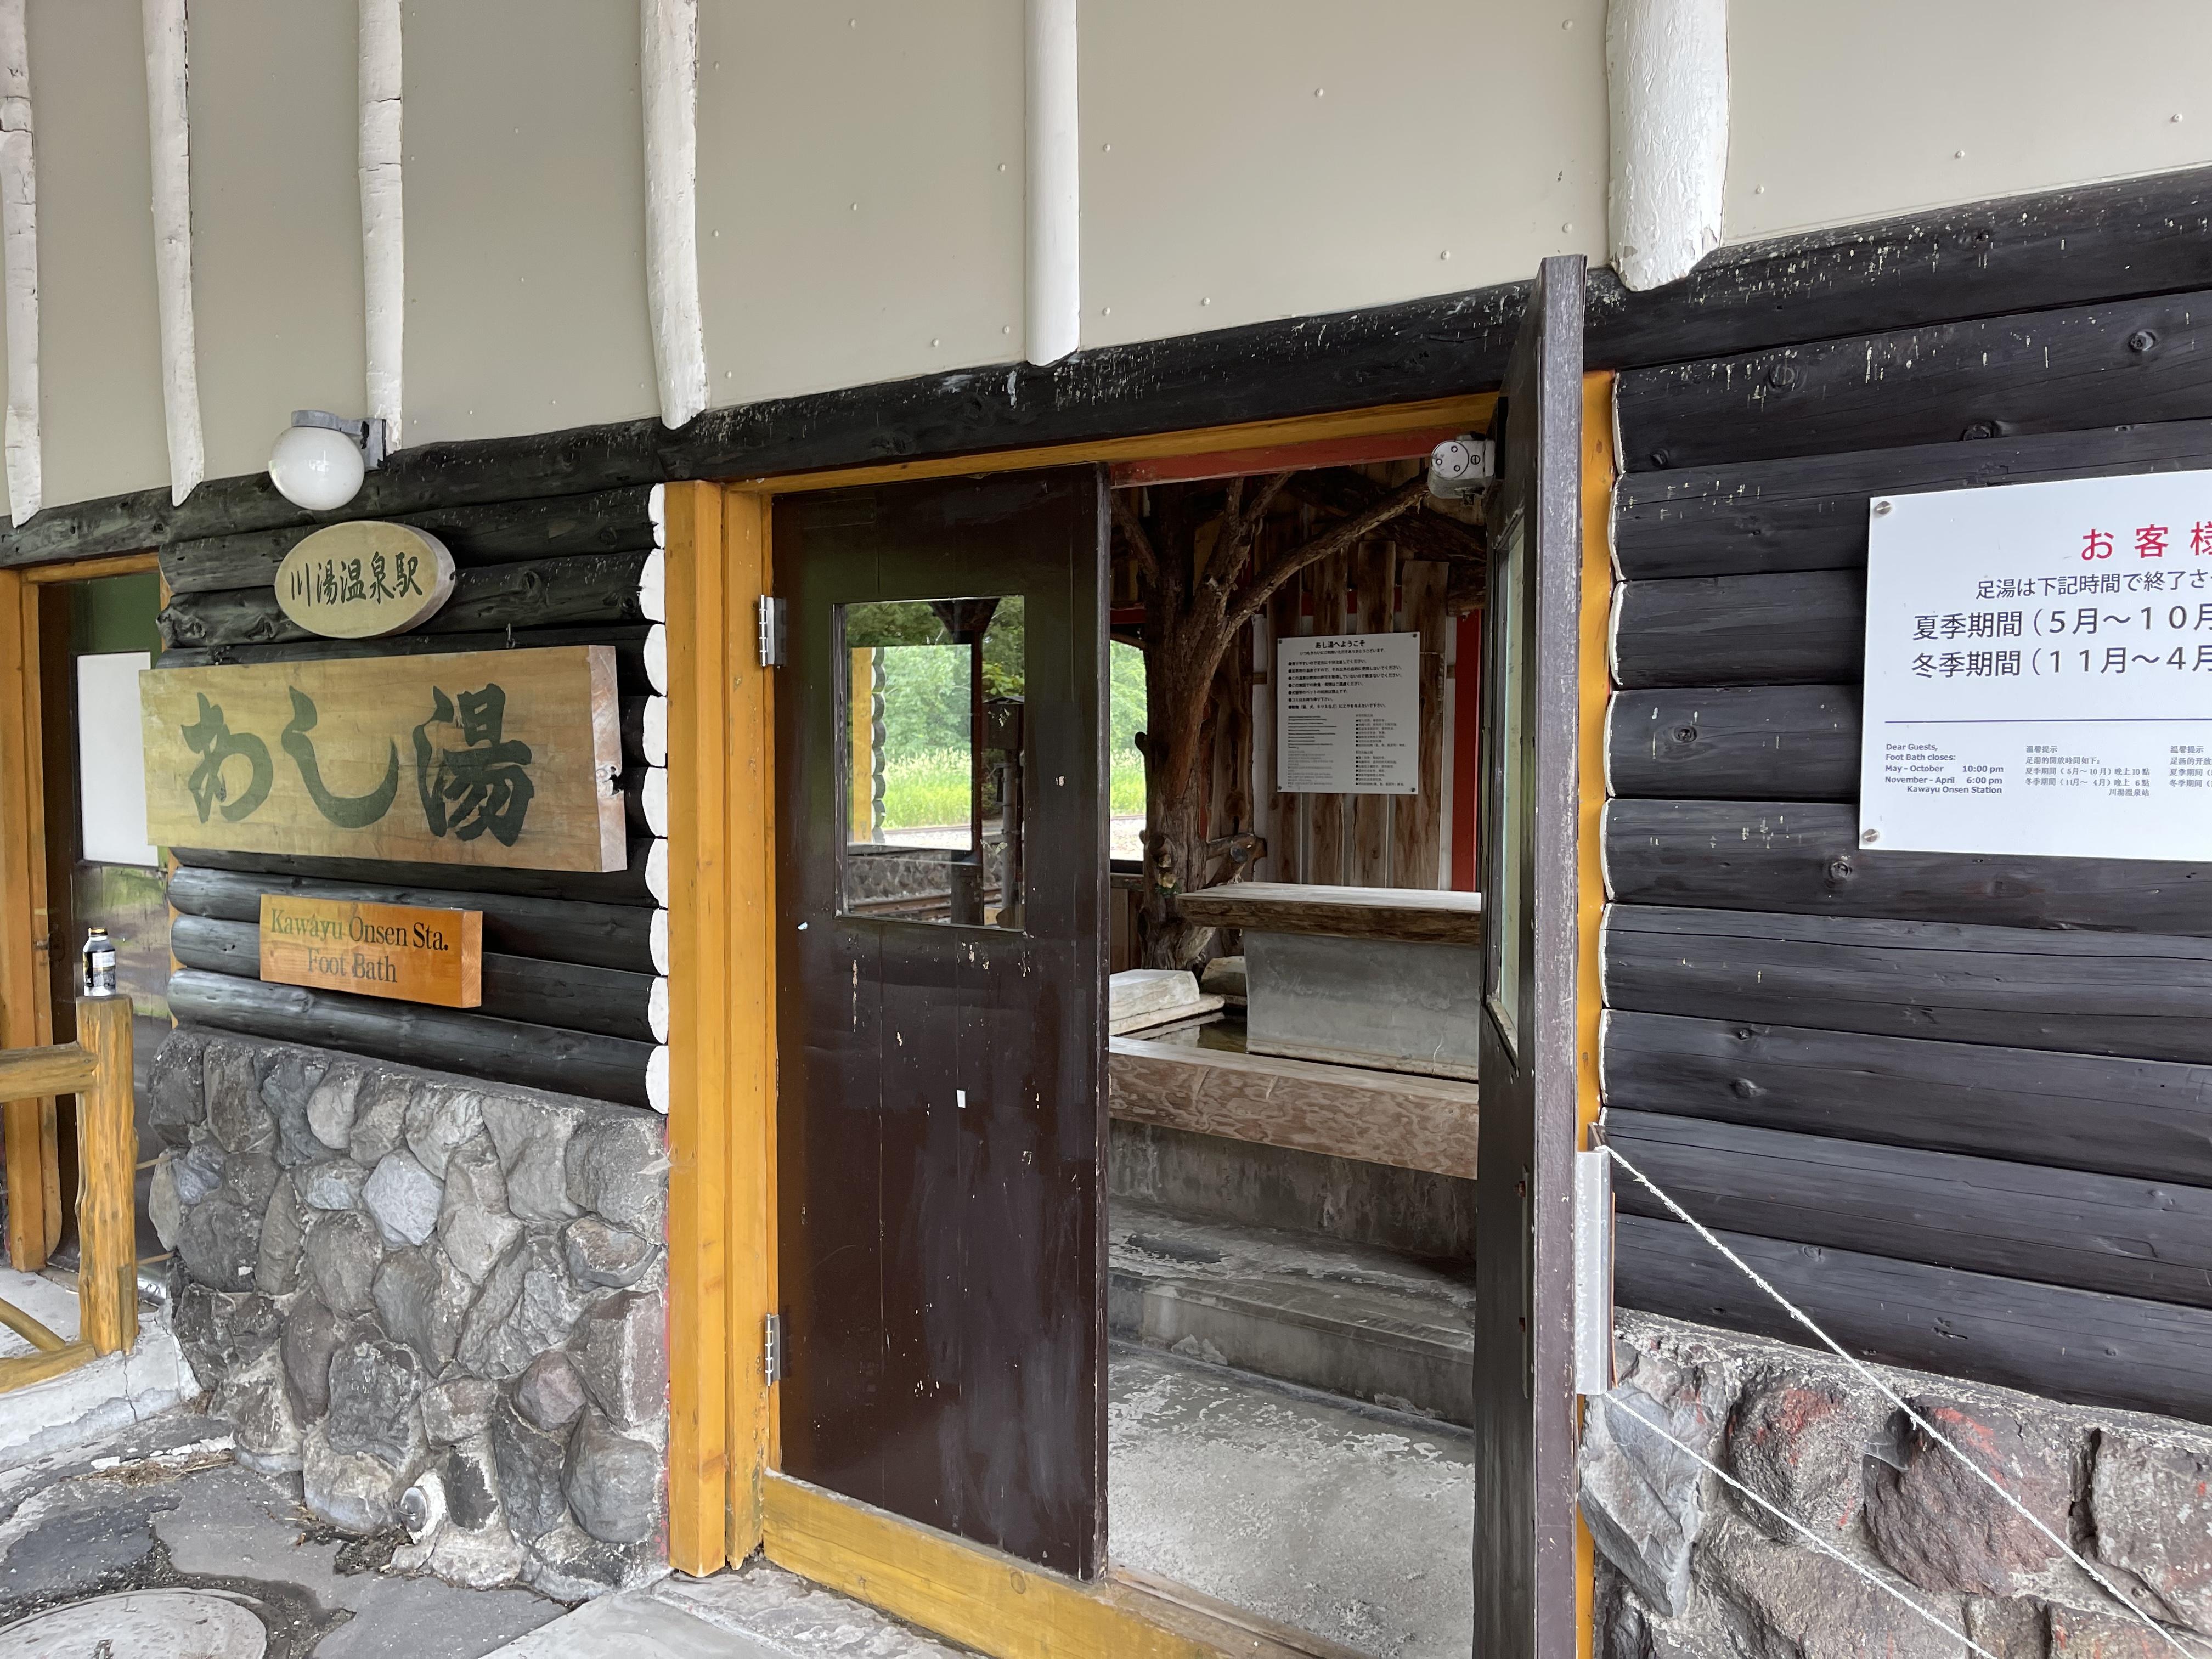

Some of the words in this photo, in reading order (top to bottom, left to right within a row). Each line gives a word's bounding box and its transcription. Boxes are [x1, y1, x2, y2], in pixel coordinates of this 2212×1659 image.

[290, 551, 425, 608] 川湯温泉駅
[1975, 568, 2212, 600] 足湯は下記時間で終了さ
[1315, 640, 1365, 649] あし湯へようこそ
[180, 682, 535, 847] あし湯
[1885, 765, 1902, 773] May
[2169, 768, 2212, 777] 夏季期间（
[1936, 776, 1955, 785] April
[2169, 779, 2212, 788] 冬季期间（
[1907, 786, 1940, 794] Kawayu
[271, 909, 342, 942] Kawayu
[349, 916, 408, 947] Onsen
[413, 922, 448, 951] Sta.
[308, 948, 346, 977] Foot
[352, 953, 397, 983] Bath
